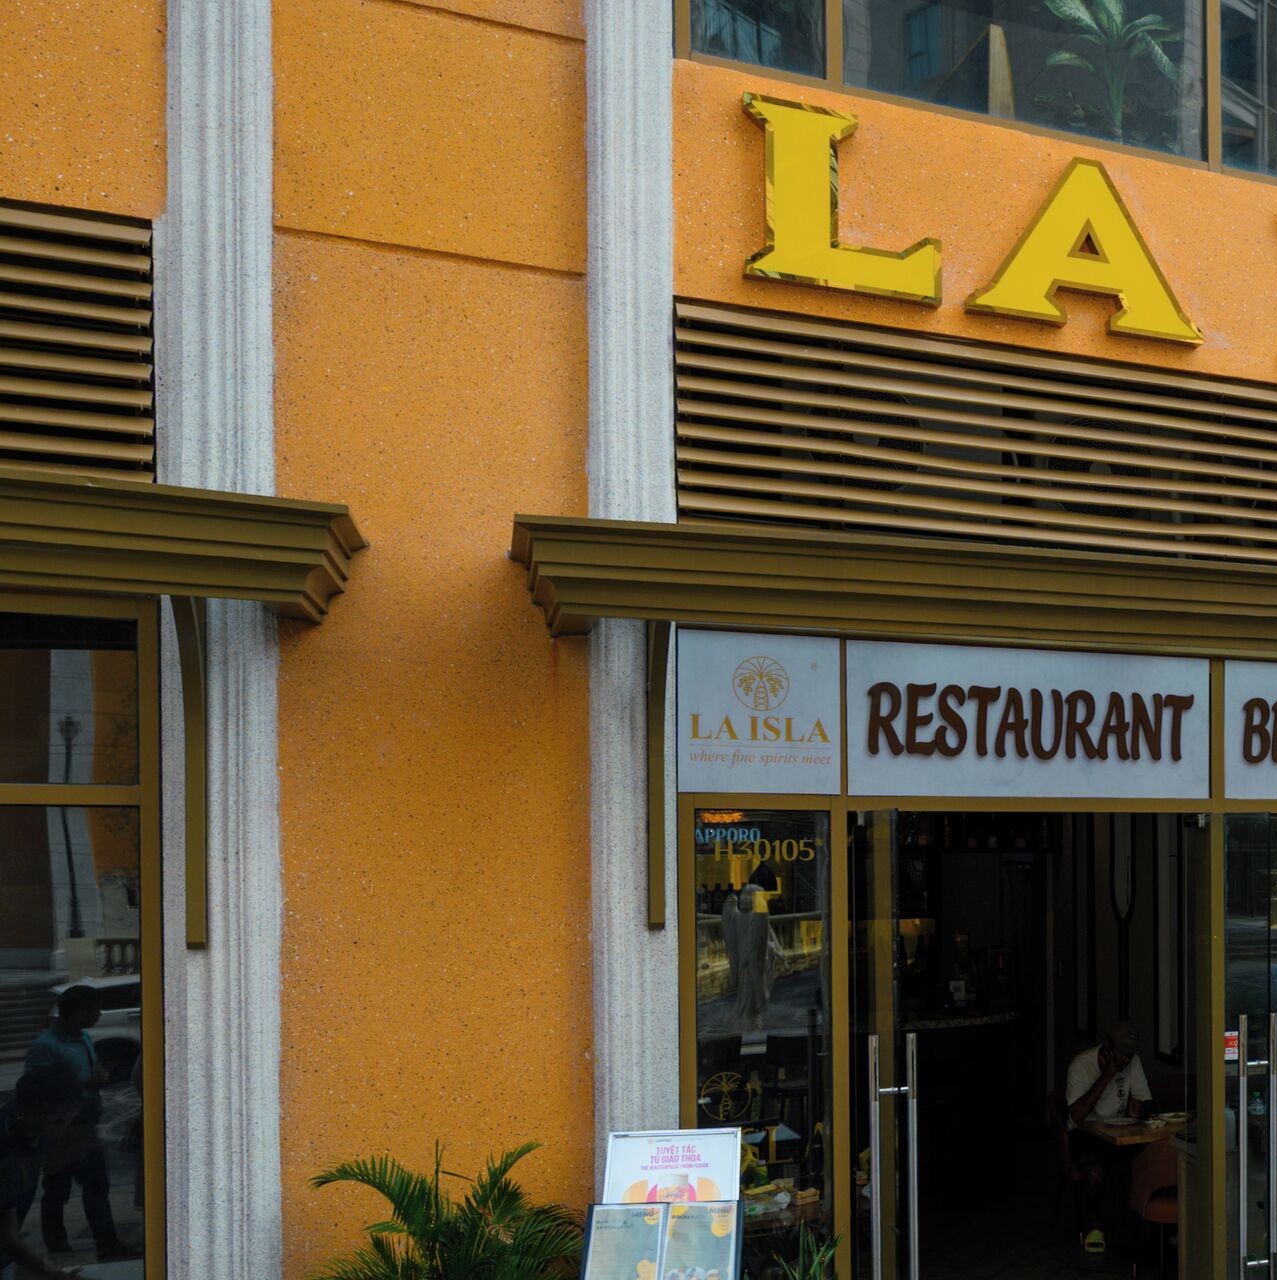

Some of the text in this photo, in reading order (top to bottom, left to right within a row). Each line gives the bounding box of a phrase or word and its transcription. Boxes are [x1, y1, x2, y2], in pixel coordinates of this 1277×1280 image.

[742, 91, 1204, 348] LA
[689, 713, 832, 744] LA ISLA
[867, 681, 1195, 763] RESTAURANT
[689, 749, 832, 769] where fine spirits meet
[695, 827, 761, 844] APPORO
[714, 838, 816, 862] H30105
